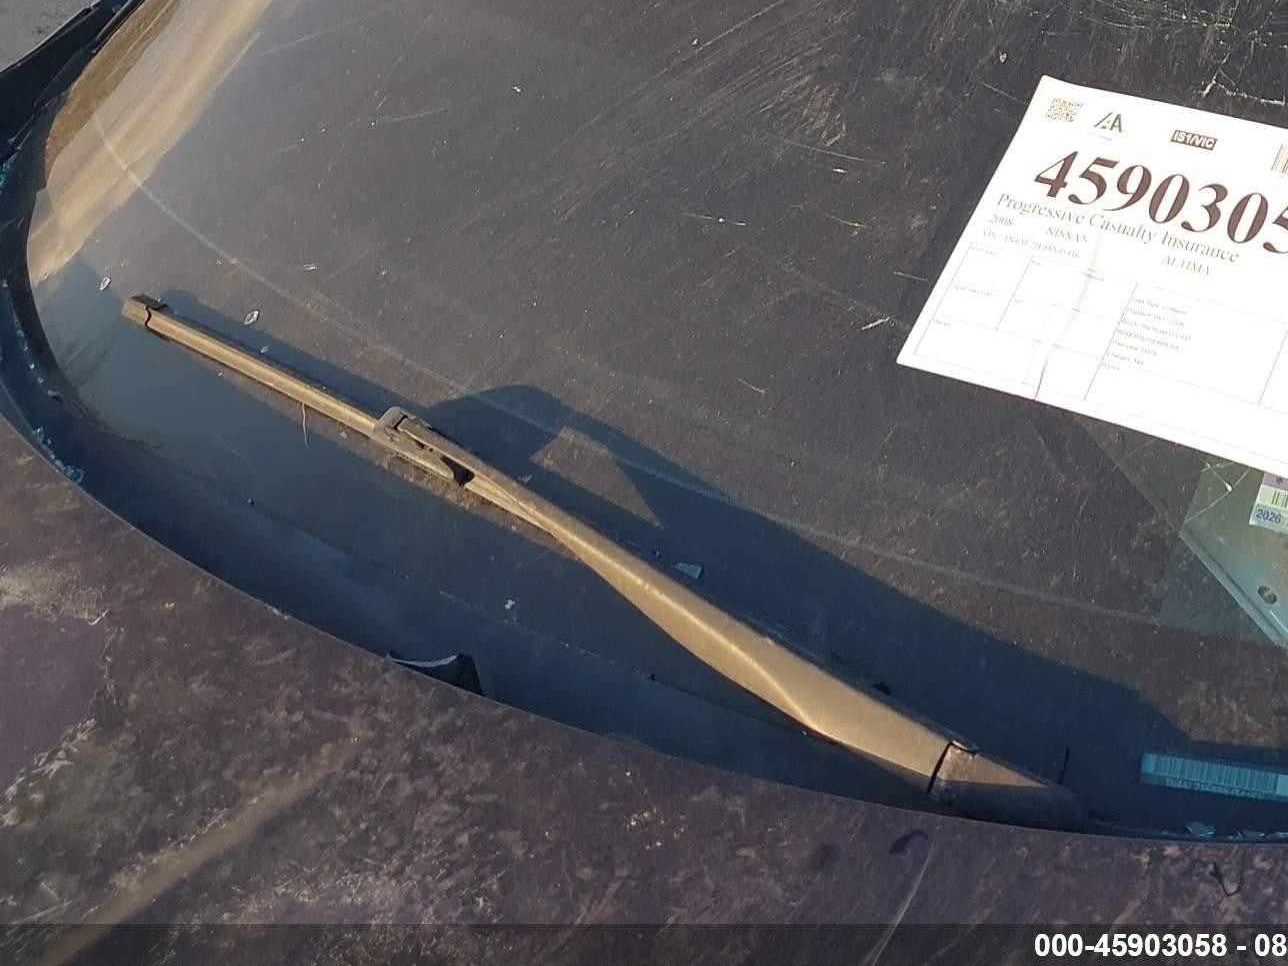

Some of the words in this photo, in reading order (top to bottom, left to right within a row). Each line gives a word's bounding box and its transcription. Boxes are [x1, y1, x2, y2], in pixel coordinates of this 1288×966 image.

[997, 193, 1085, 225] Progressive
[1089, 213, 1156, 244] Casualty
[1161, 231, 1240, 263] Insurance
[1046, 225, 1088, 243] NISSAN
[1256, 508, 1281, 524] 2026
